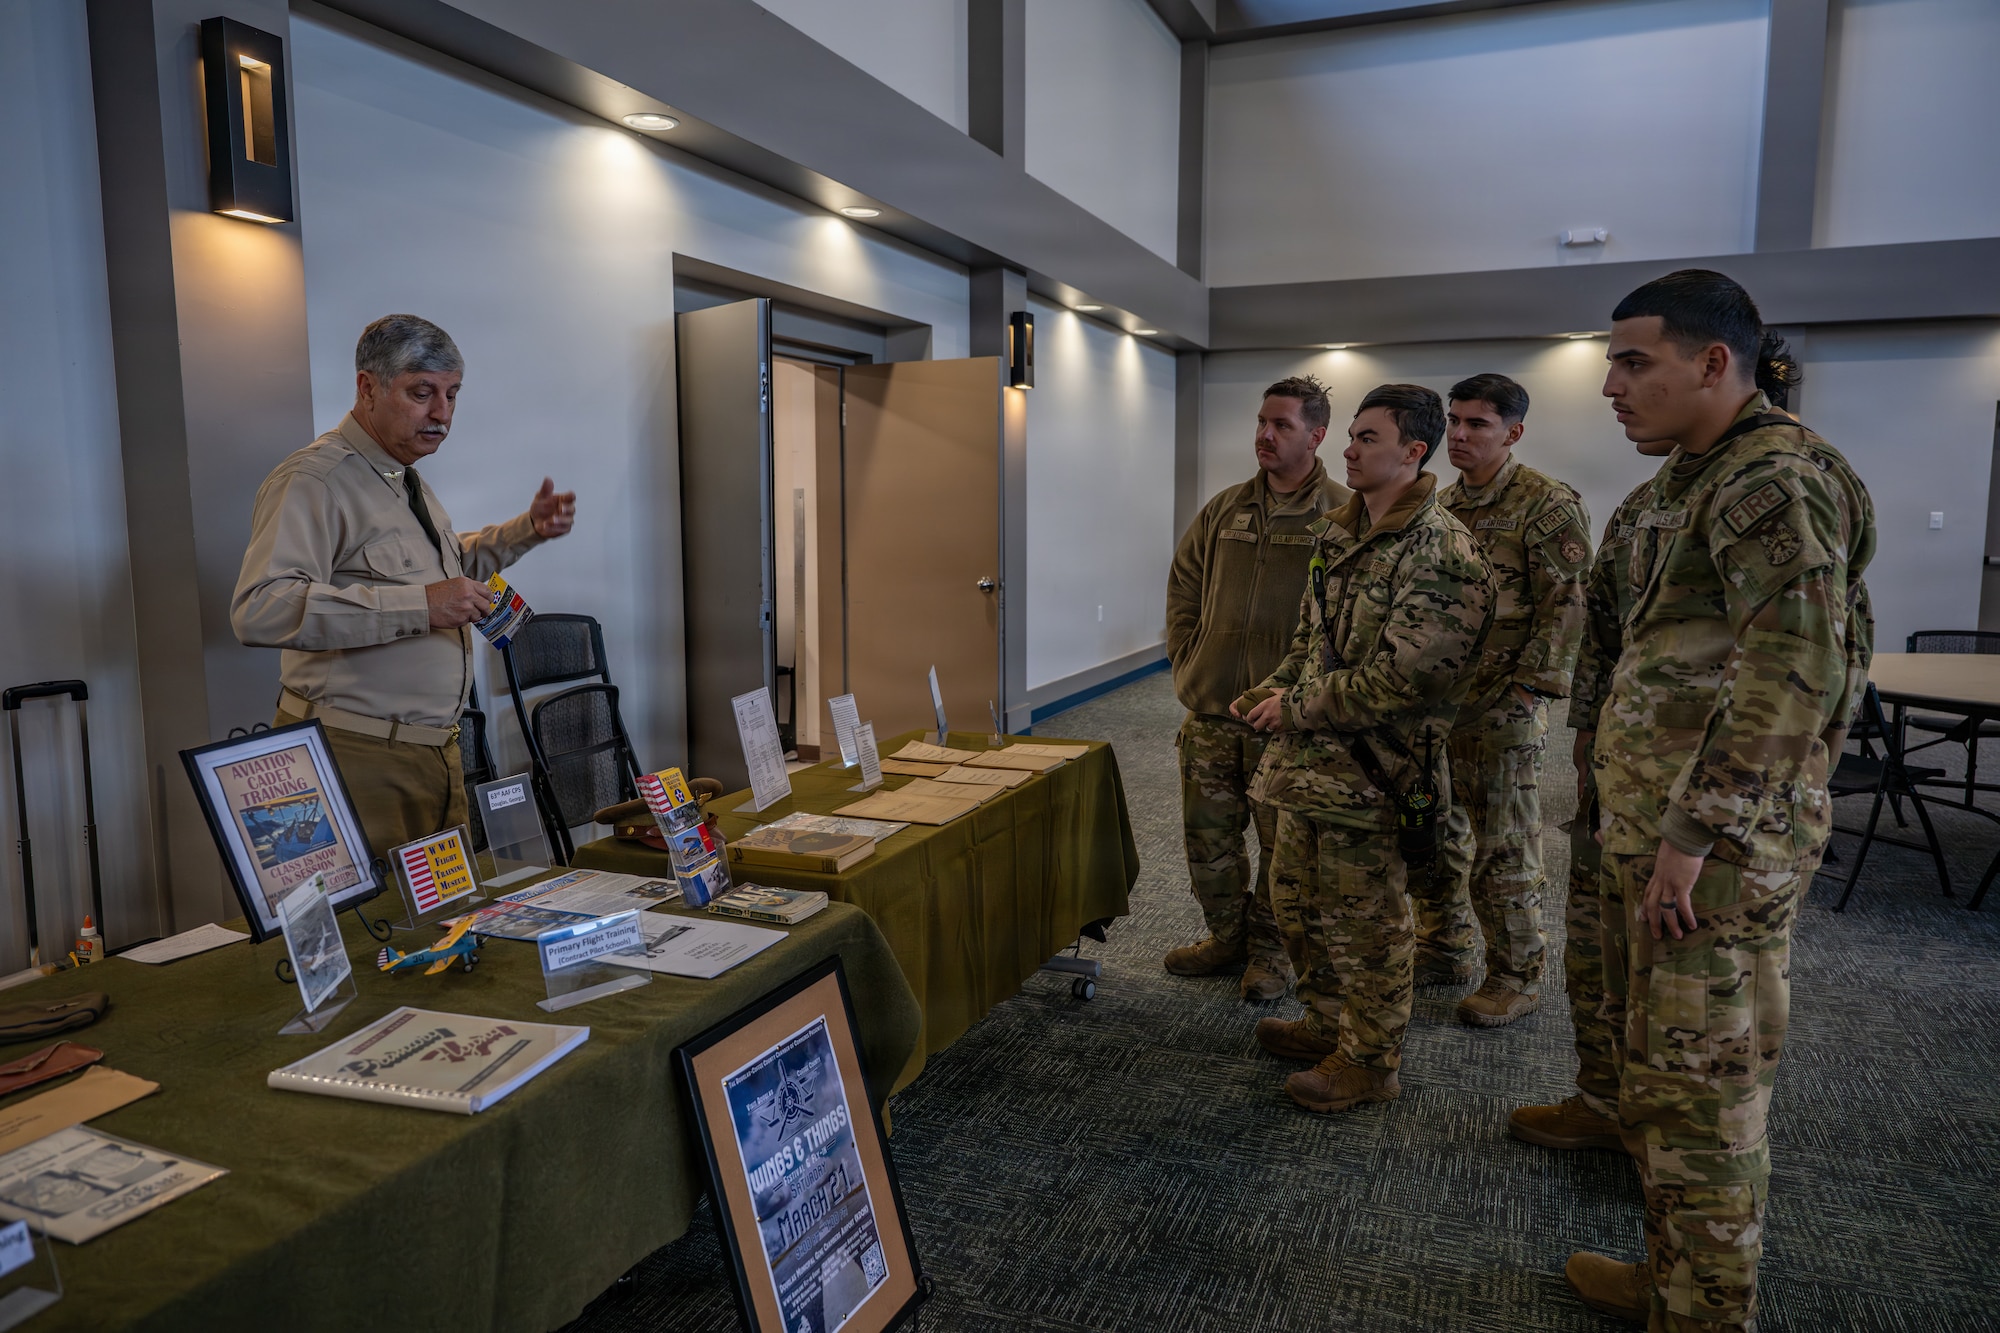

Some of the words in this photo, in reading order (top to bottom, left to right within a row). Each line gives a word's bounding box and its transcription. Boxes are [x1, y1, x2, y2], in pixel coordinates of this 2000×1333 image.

[1540, 510, 1566, 532] FIRE
[1729, 485, 1782, 530] FIRE
[1495, 520, 1514, 529] FORCE
[1294, 536, 1313, 544] FORCE
[232, 752, 296, 779] AVIATION
[247, 767, 292, 790] CADET
[240, 777, 307, 806] TRAINING
[270, 860, 301, 878] CLASS
[303, 855, 313, 866] IS
[315, 847, 337, 863] NOW
[281, 876, 293, 886] IN
[295, 859, 335, 881] SESSION
[435, 854, 457, 866] FLIGHT
[435, 864, 464, 879] TRAINING
[330, 870, 356, 886] CORPS
[440, 876, 466, 890] MUSEUM
[548, 941, 581, 956] Primary
[582, 934, 604, 946] Flight
[606, 924, 636, 939] Training
[558, 951, 588, 965] (Contract
[590, 946, 604, 955] Pilot
[606, 937, 631, 950] Schools)
[776, 1046, 790, 1059] CHAMBER
[808, 1057, 821, 1068] COUNTY
[757, 1089, 774, 1104] DOUGLAS
[750, 1146, 794, 1194] WINGS
[793, 1136, 805, 1162] &
[804, 1104, 847, 1152] THINGS
[784, 1166, 806, 1186] FESTIVAL
[811, 1146, 827, 1163] FLY-IN
[790, 1161, 826, 1198] SATURDAY
[778, 1186, 830, 1250] MARCH
[828, 1162, 852, 1205] 21
[779, 1274, 797, 1293] DOUGLAS
[796, 1256, 815, 1280] MUNICIPAL
[815, 1248, 824, 1260] GENE
[824, 1232, 841, 1250] CHAMBERS
[841, 1218, 854, 1236] AIRPORT
